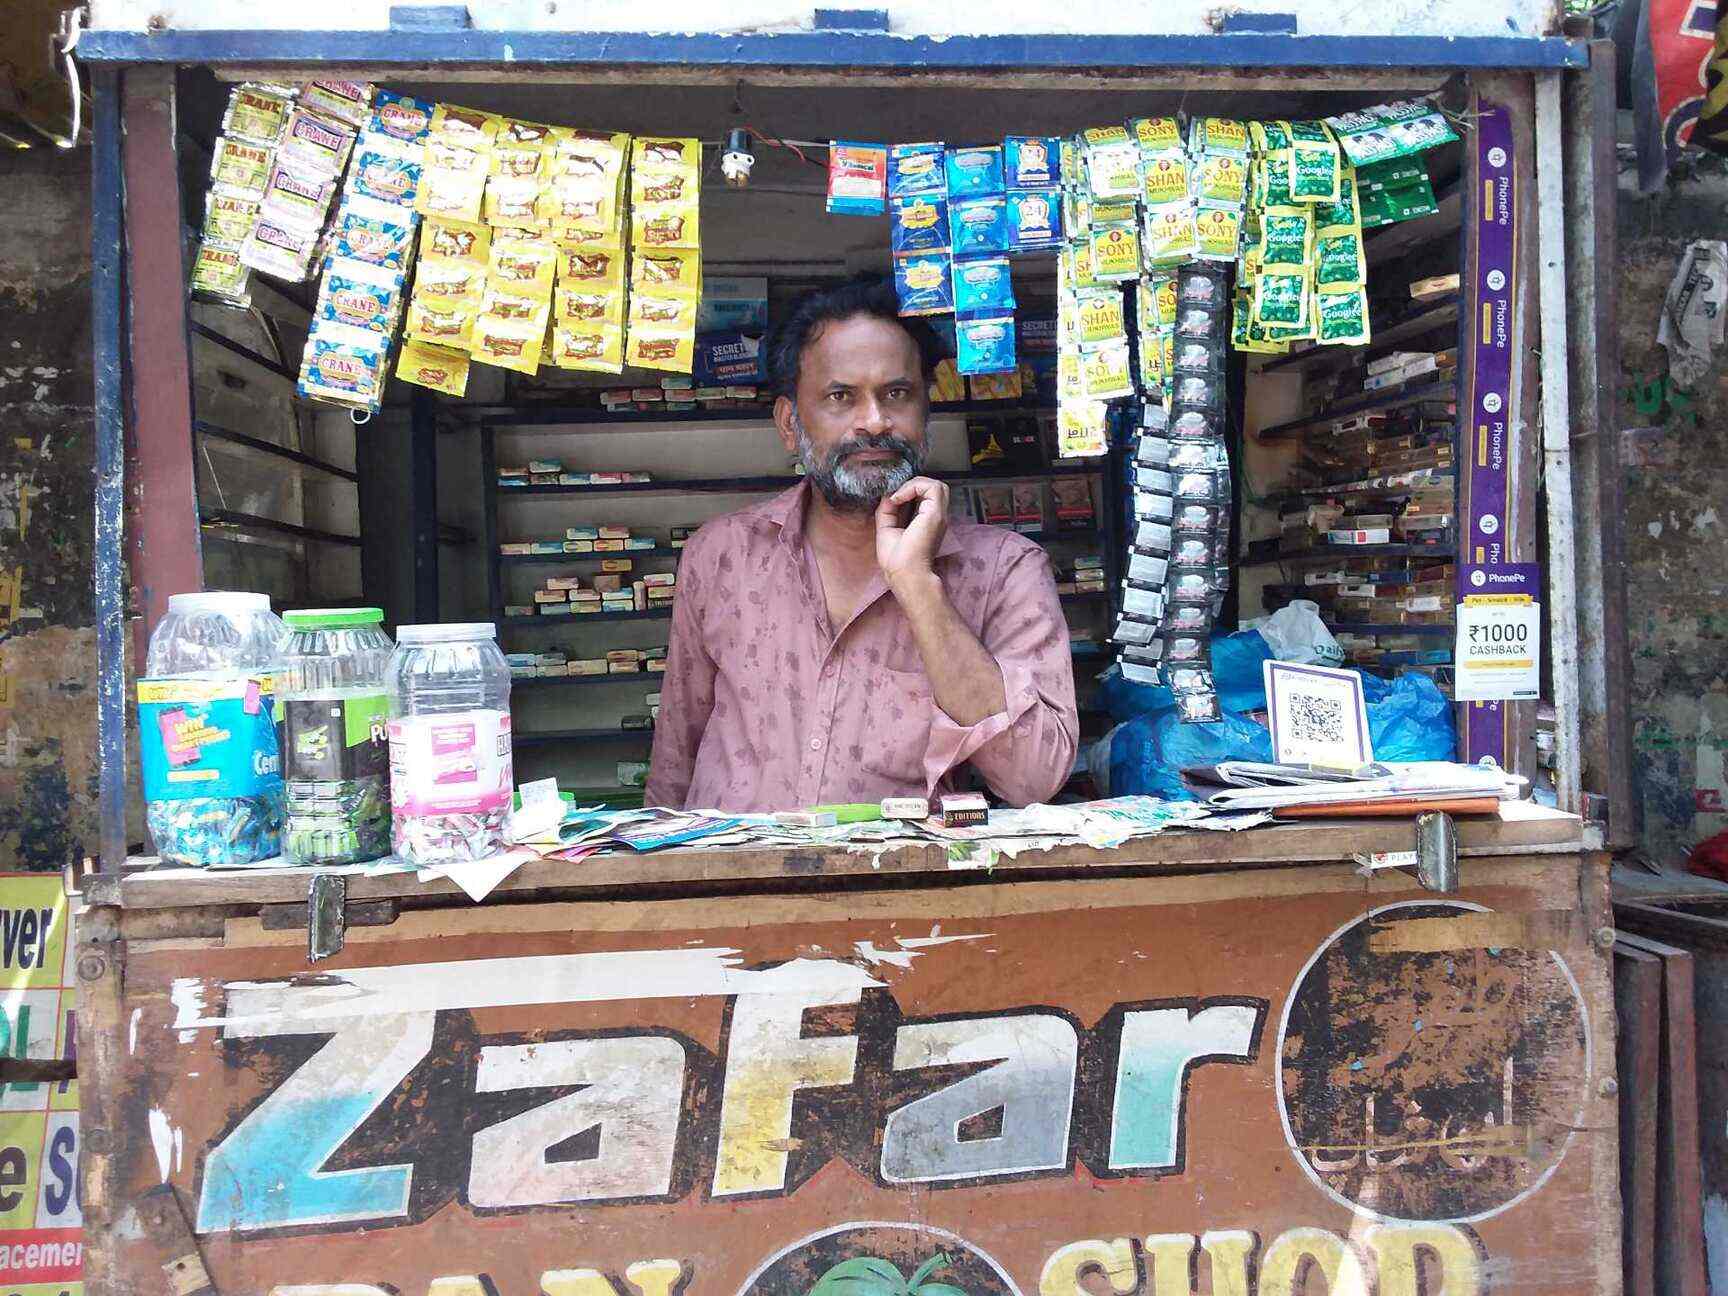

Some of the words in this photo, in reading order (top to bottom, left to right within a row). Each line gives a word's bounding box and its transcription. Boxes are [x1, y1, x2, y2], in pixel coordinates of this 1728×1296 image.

[1206, 124, 1245, 137] SHAN
[1147, 172, 1185, 188] SHAN
[1499, 177, 1509, 225] PhonePe
[1197, 223, 1237, 238] SONY
[1098, 241, 1135, 258] SONY
[336, 295, 376, 313] CRANE
[1081, 311, 1120, 327] SHAN
[1497, 300, 1507, 348] PhonePe
[1492, 422, 1502, 471] PhonePe
[1488, 573, 1526, 583] PhonePe
[1469, 623, 1528, 642] ₹1000
[1469, 645, 1527, 656] CASHBACK
[0, 908, 53, 969] ver
[45, 1126, 82, 1216] S
